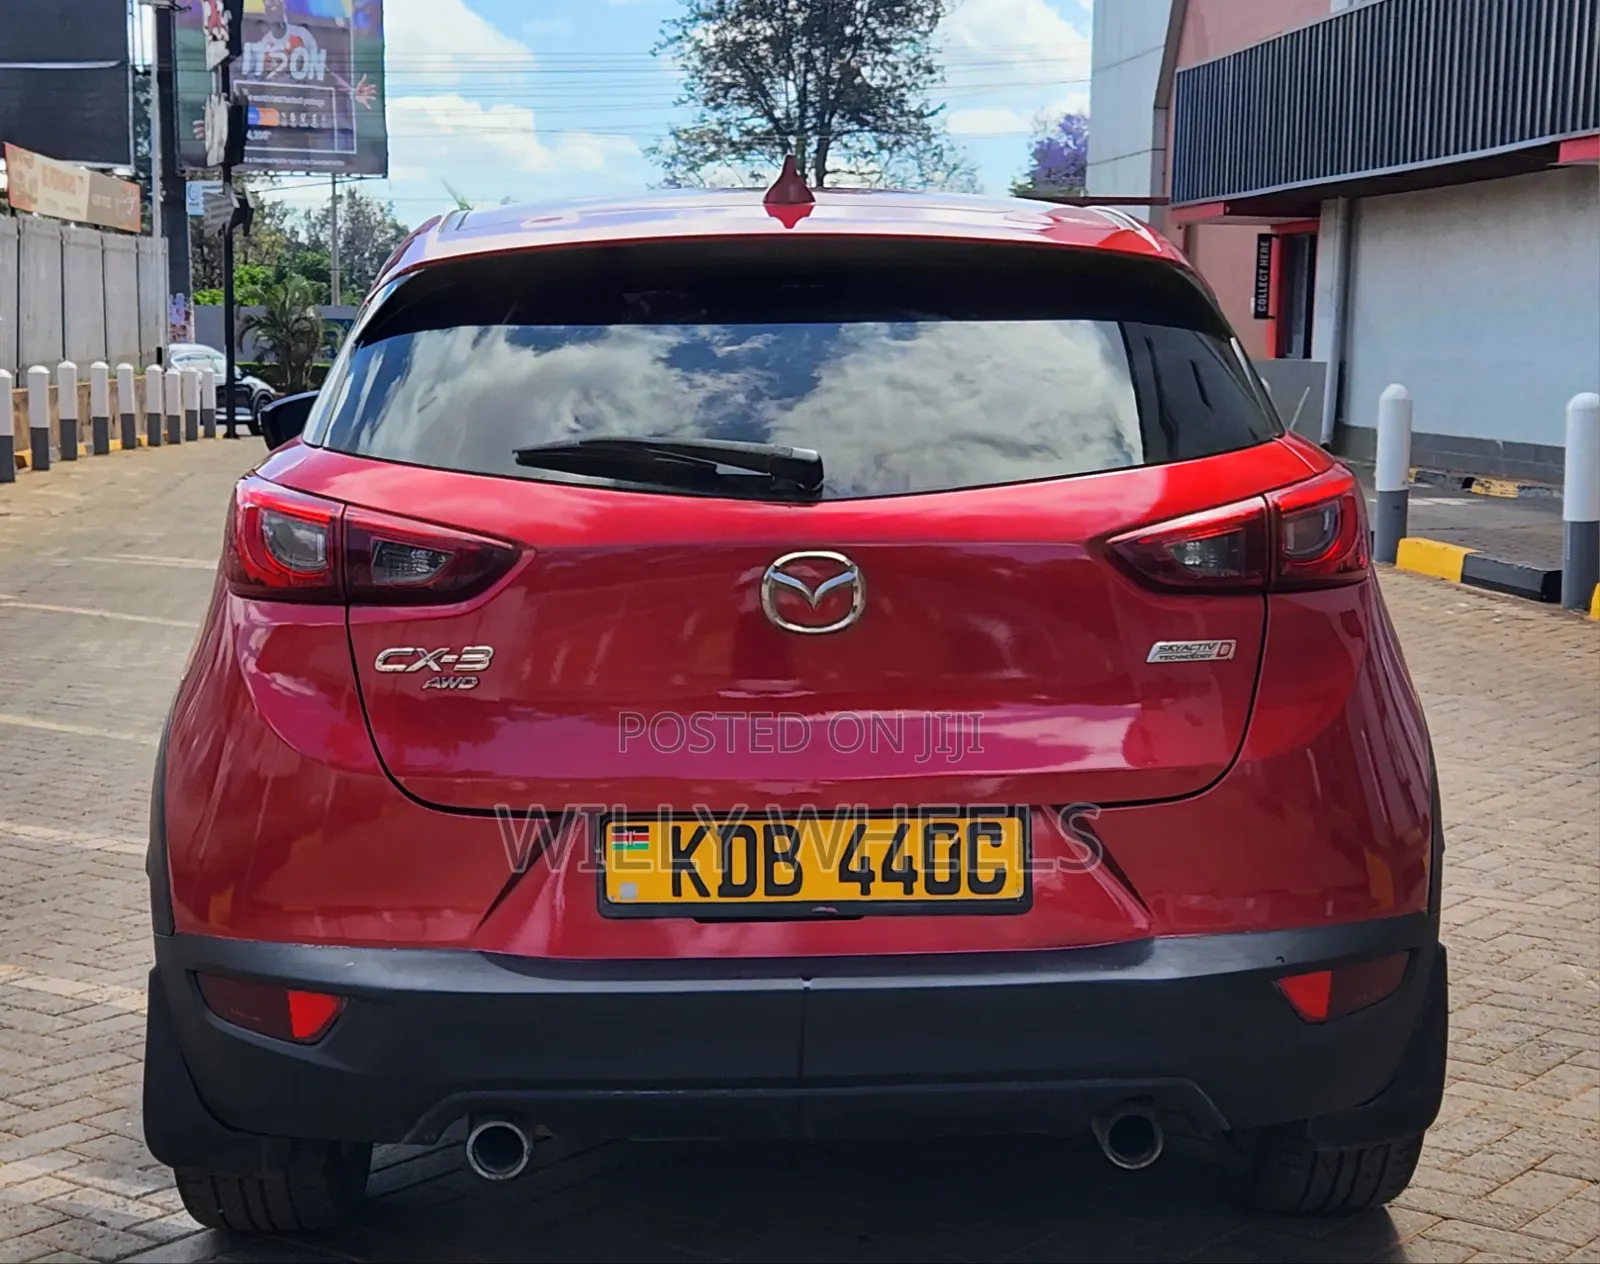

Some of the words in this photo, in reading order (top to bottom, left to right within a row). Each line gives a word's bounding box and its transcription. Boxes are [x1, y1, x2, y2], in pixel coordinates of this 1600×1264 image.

[1259, 240, 1270, 267] HERE
[1257, 269, 1269, 312] COLLECT
[374, 645, 494, 672] CX-3
[1158, 642, 1217, 653] SKYACTIV
[421, 676, 479, 690] AWD
[670, 824, 803, 898] KDB
